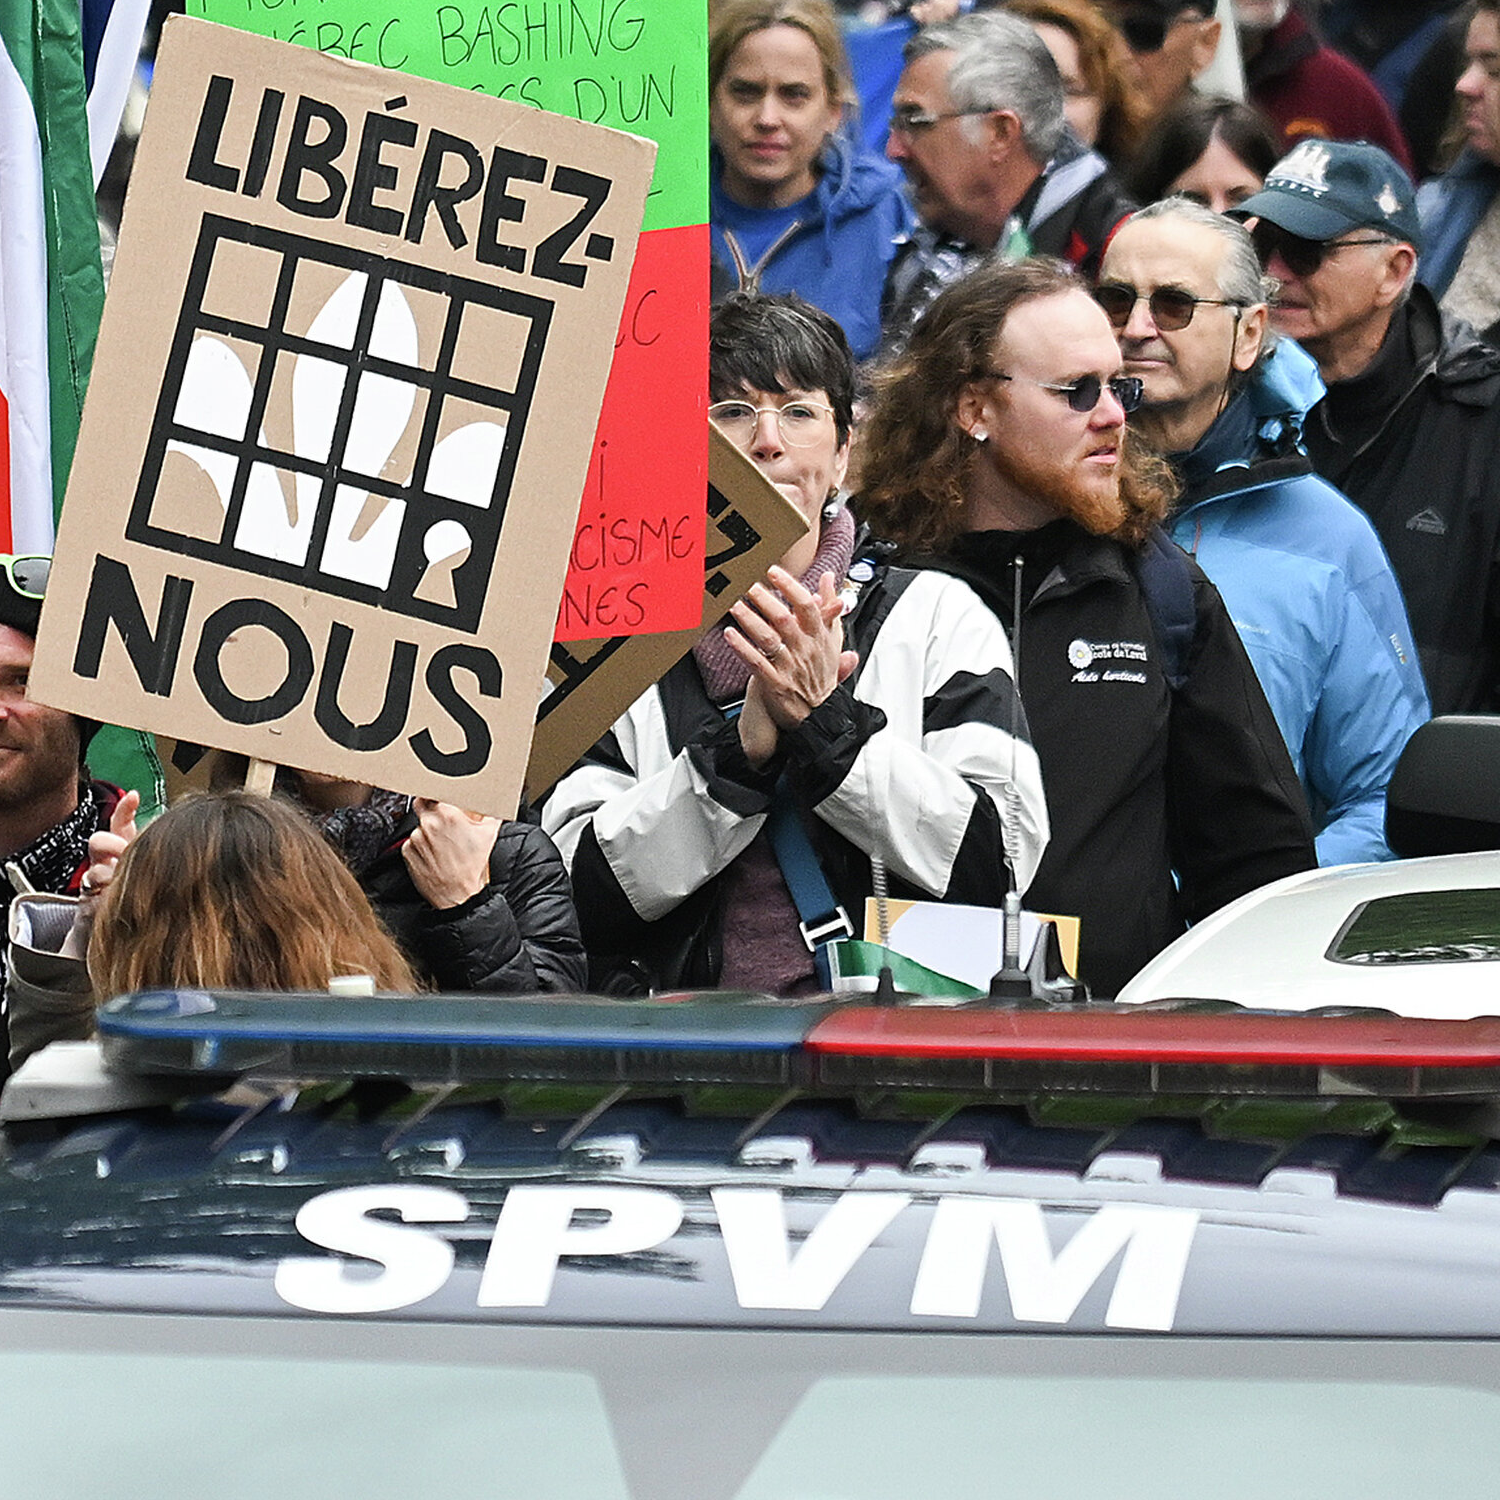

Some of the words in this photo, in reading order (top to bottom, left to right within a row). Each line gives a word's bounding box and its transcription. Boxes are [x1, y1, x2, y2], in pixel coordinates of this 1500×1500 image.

[574, 64, 676, 125] D'UN
[186, 74, 615, 289] LIBÉREZ-
[569, 512, 694, 573] CISME
[73, 553, 504, 777] NOUS
[275, 1183, 1201, 1331] SPVM
